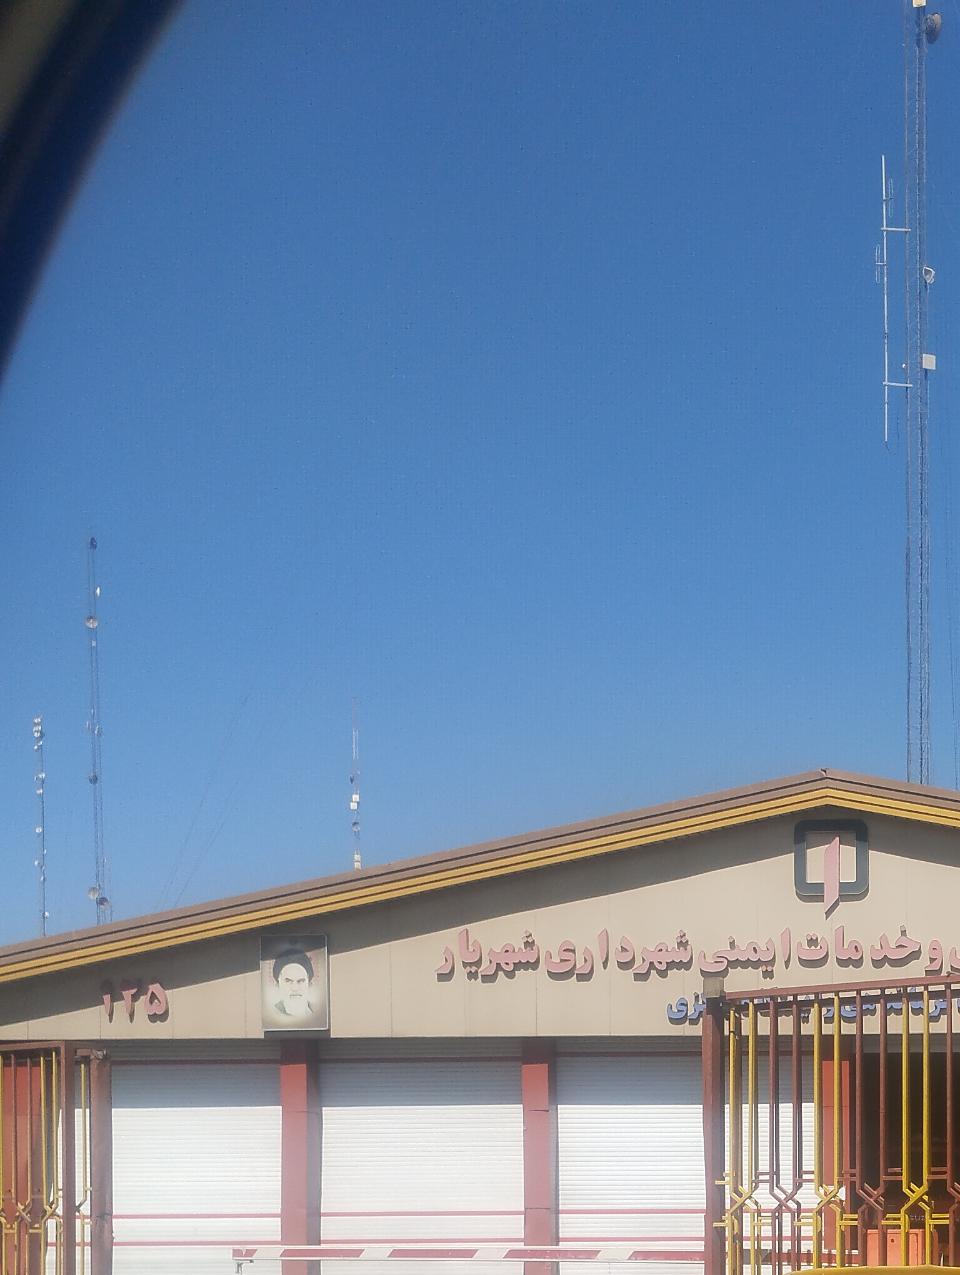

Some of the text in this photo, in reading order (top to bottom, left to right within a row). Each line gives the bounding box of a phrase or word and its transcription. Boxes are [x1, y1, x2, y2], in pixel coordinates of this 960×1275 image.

[434, 927, 540, 975] شهریار
[544, 928, 693, 975] شهرداری
[699, 926, 790, 973] ایمنی
[797, 924, 922, 963] خدمات
[924, 939, 944, 971] و
[102, 979, 168, 1015] ۱۲۵
